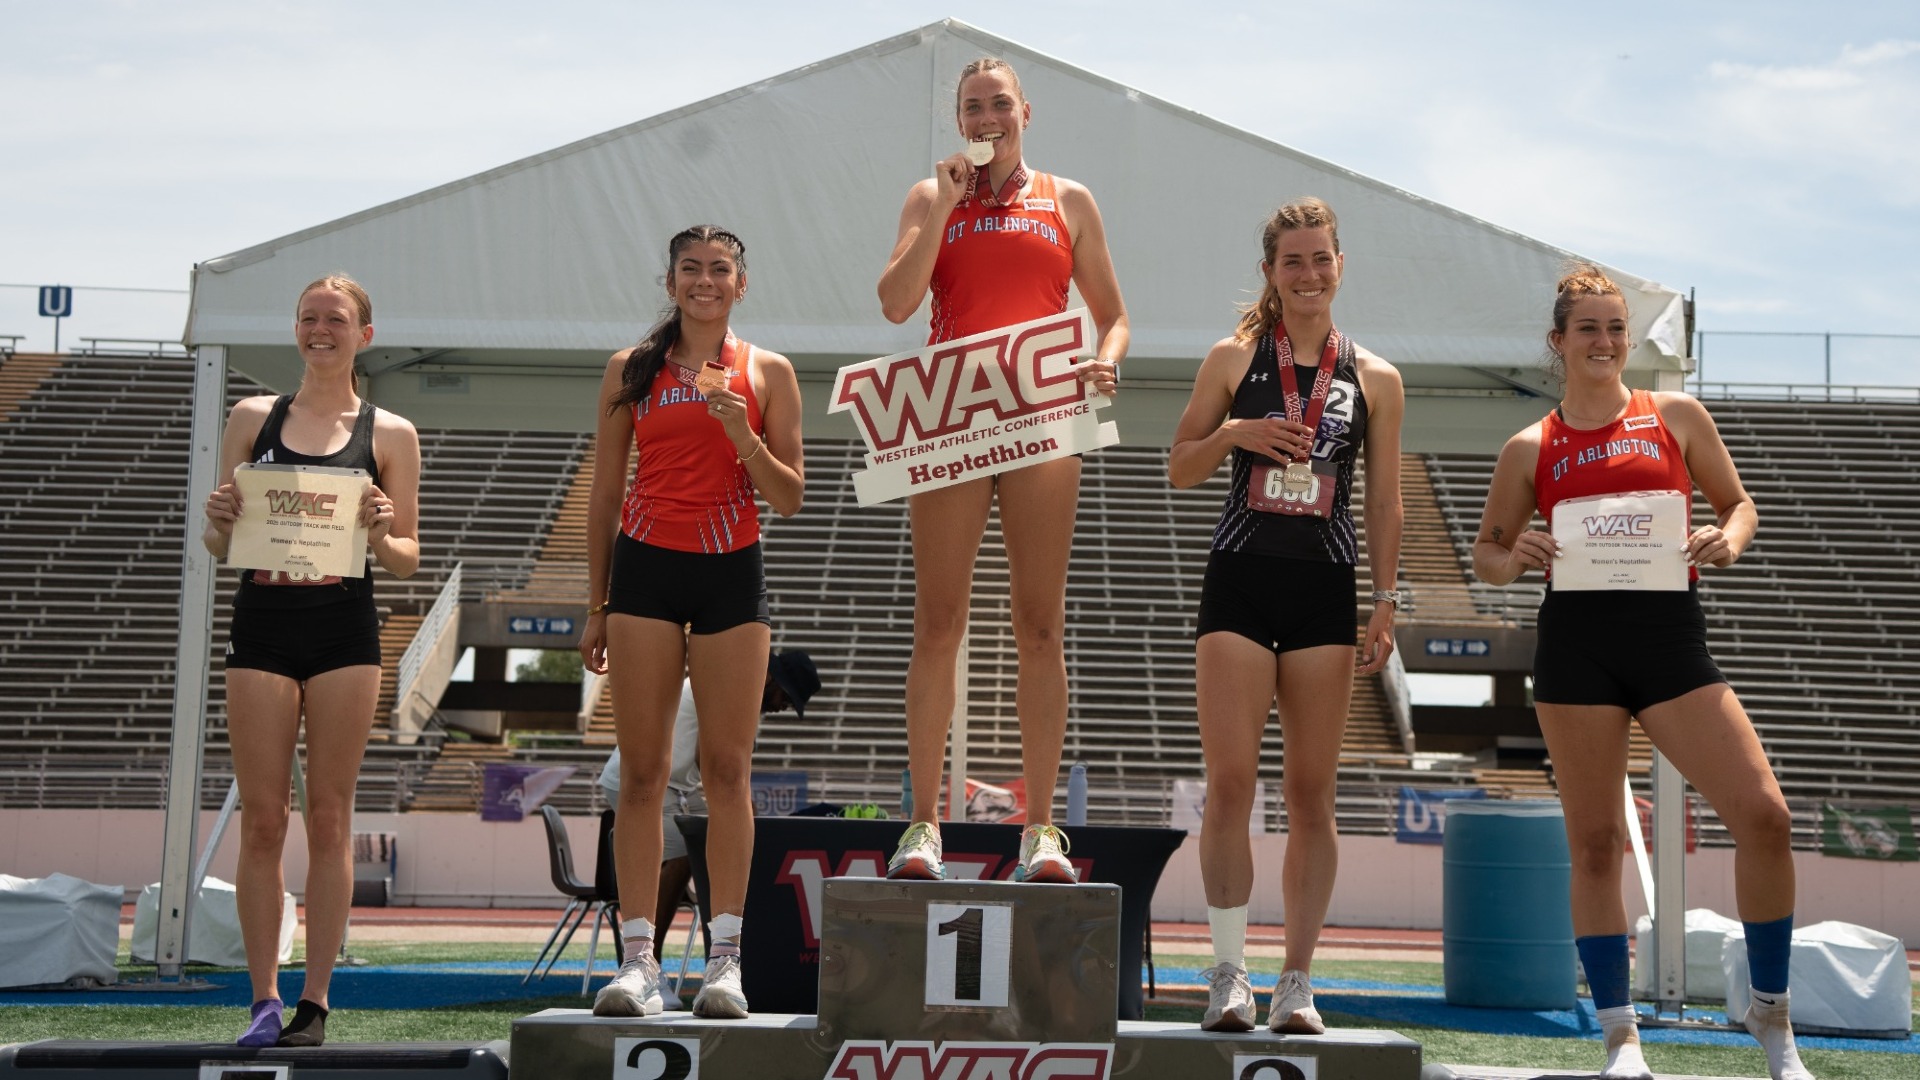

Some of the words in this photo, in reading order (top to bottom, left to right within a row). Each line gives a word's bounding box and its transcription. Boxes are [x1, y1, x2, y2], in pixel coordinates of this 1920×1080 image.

[948, 221, 966, 244] UT
[974, 216, 1058, 247] ARLINGTON
[44, 287, 67, 316] U
[1280, 336, 1294, 367] WAC
[838, 316, 1086, 451] WAC
[1311, 369, 1330, 400] WAC
[637, 396, 652, 421] UT
[659, 386, 708, 407] ARLIN
[1325, 386, 1348, 417] 2
[873, 442, 935, 466] WESTERN
[939, 426, 1001, 450] ATHLETIC
[1004, 403, 1090, 433] CONFERENCE
[908, 437, 1059, 486] Heptathlon
[1553, 456, 1569, 482] UT
[1577, 438, 1661, 467] ARLINGTON
[265, 489, 338, 517] WAC
[1582, 514, 1653, 536] WAC
[938, 909, 983, 1000] 1
